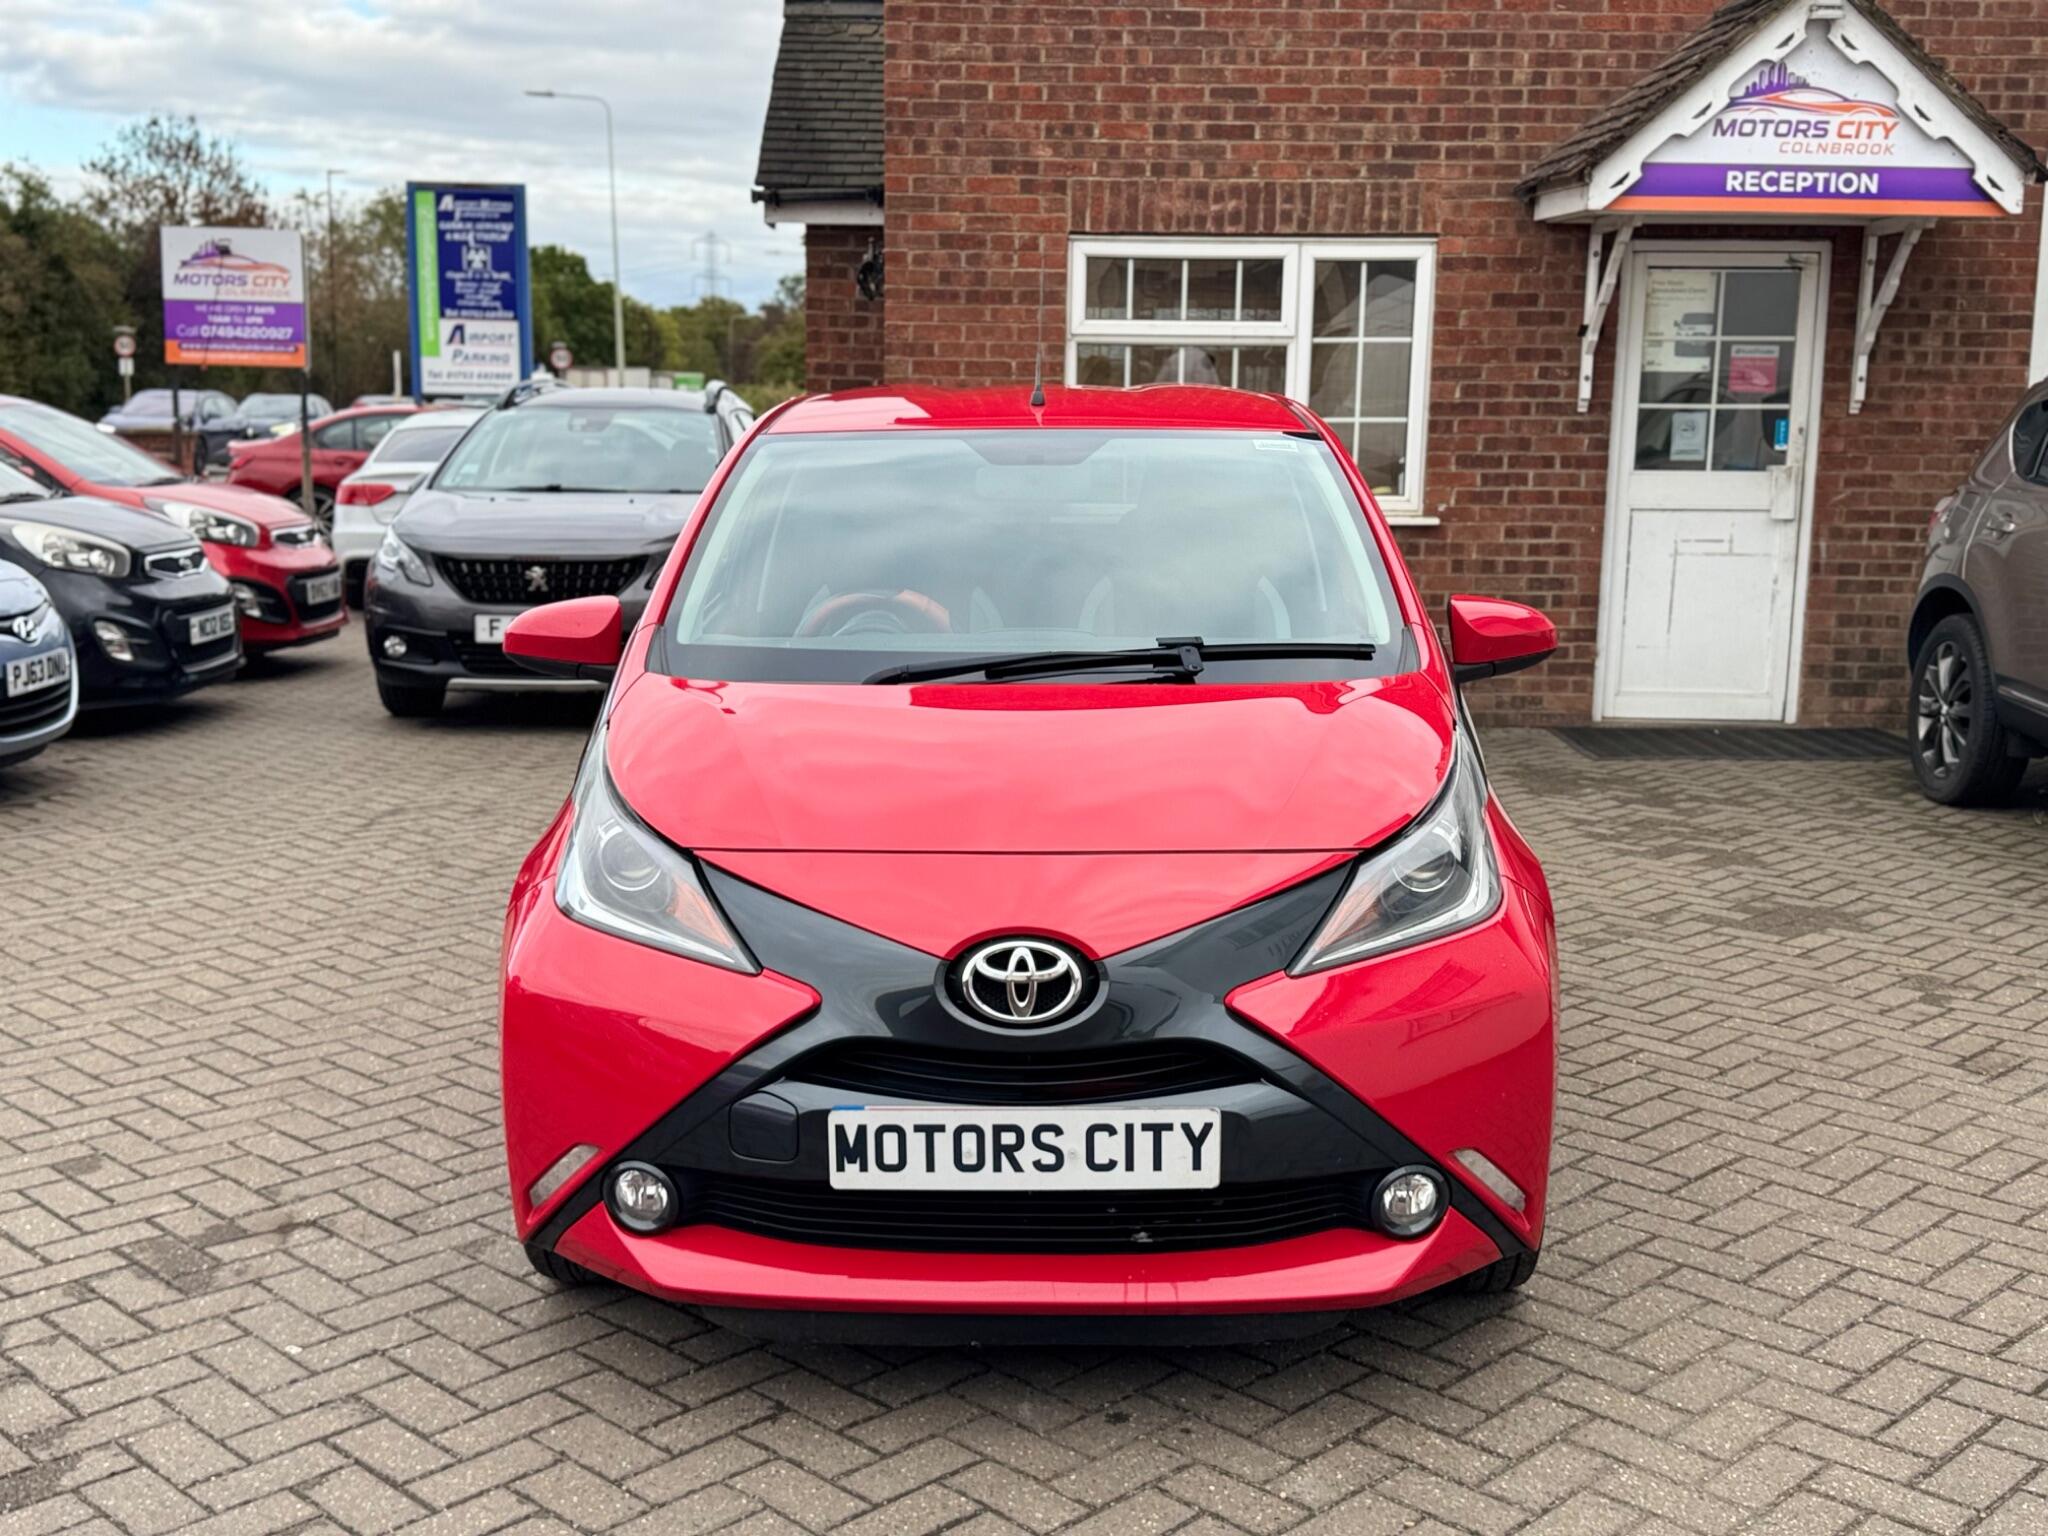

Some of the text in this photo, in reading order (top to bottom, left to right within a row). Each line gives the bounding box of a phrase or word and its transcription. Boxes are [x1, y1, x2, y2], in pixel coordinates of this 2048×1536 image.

[1712, 118, 1900, 140] MOTORS CITY
[1778, 141, 1895, 156] COLNBROOK
[1725, 170, 1880, 194] RECEPTION
[173, 273, 291, 287] MOTORS CITY
[176, 324, 198, 337] Call
[13, 659, 44, 689] PJ63
[835, 1122, 1214, 1173] MOTORS CITY
